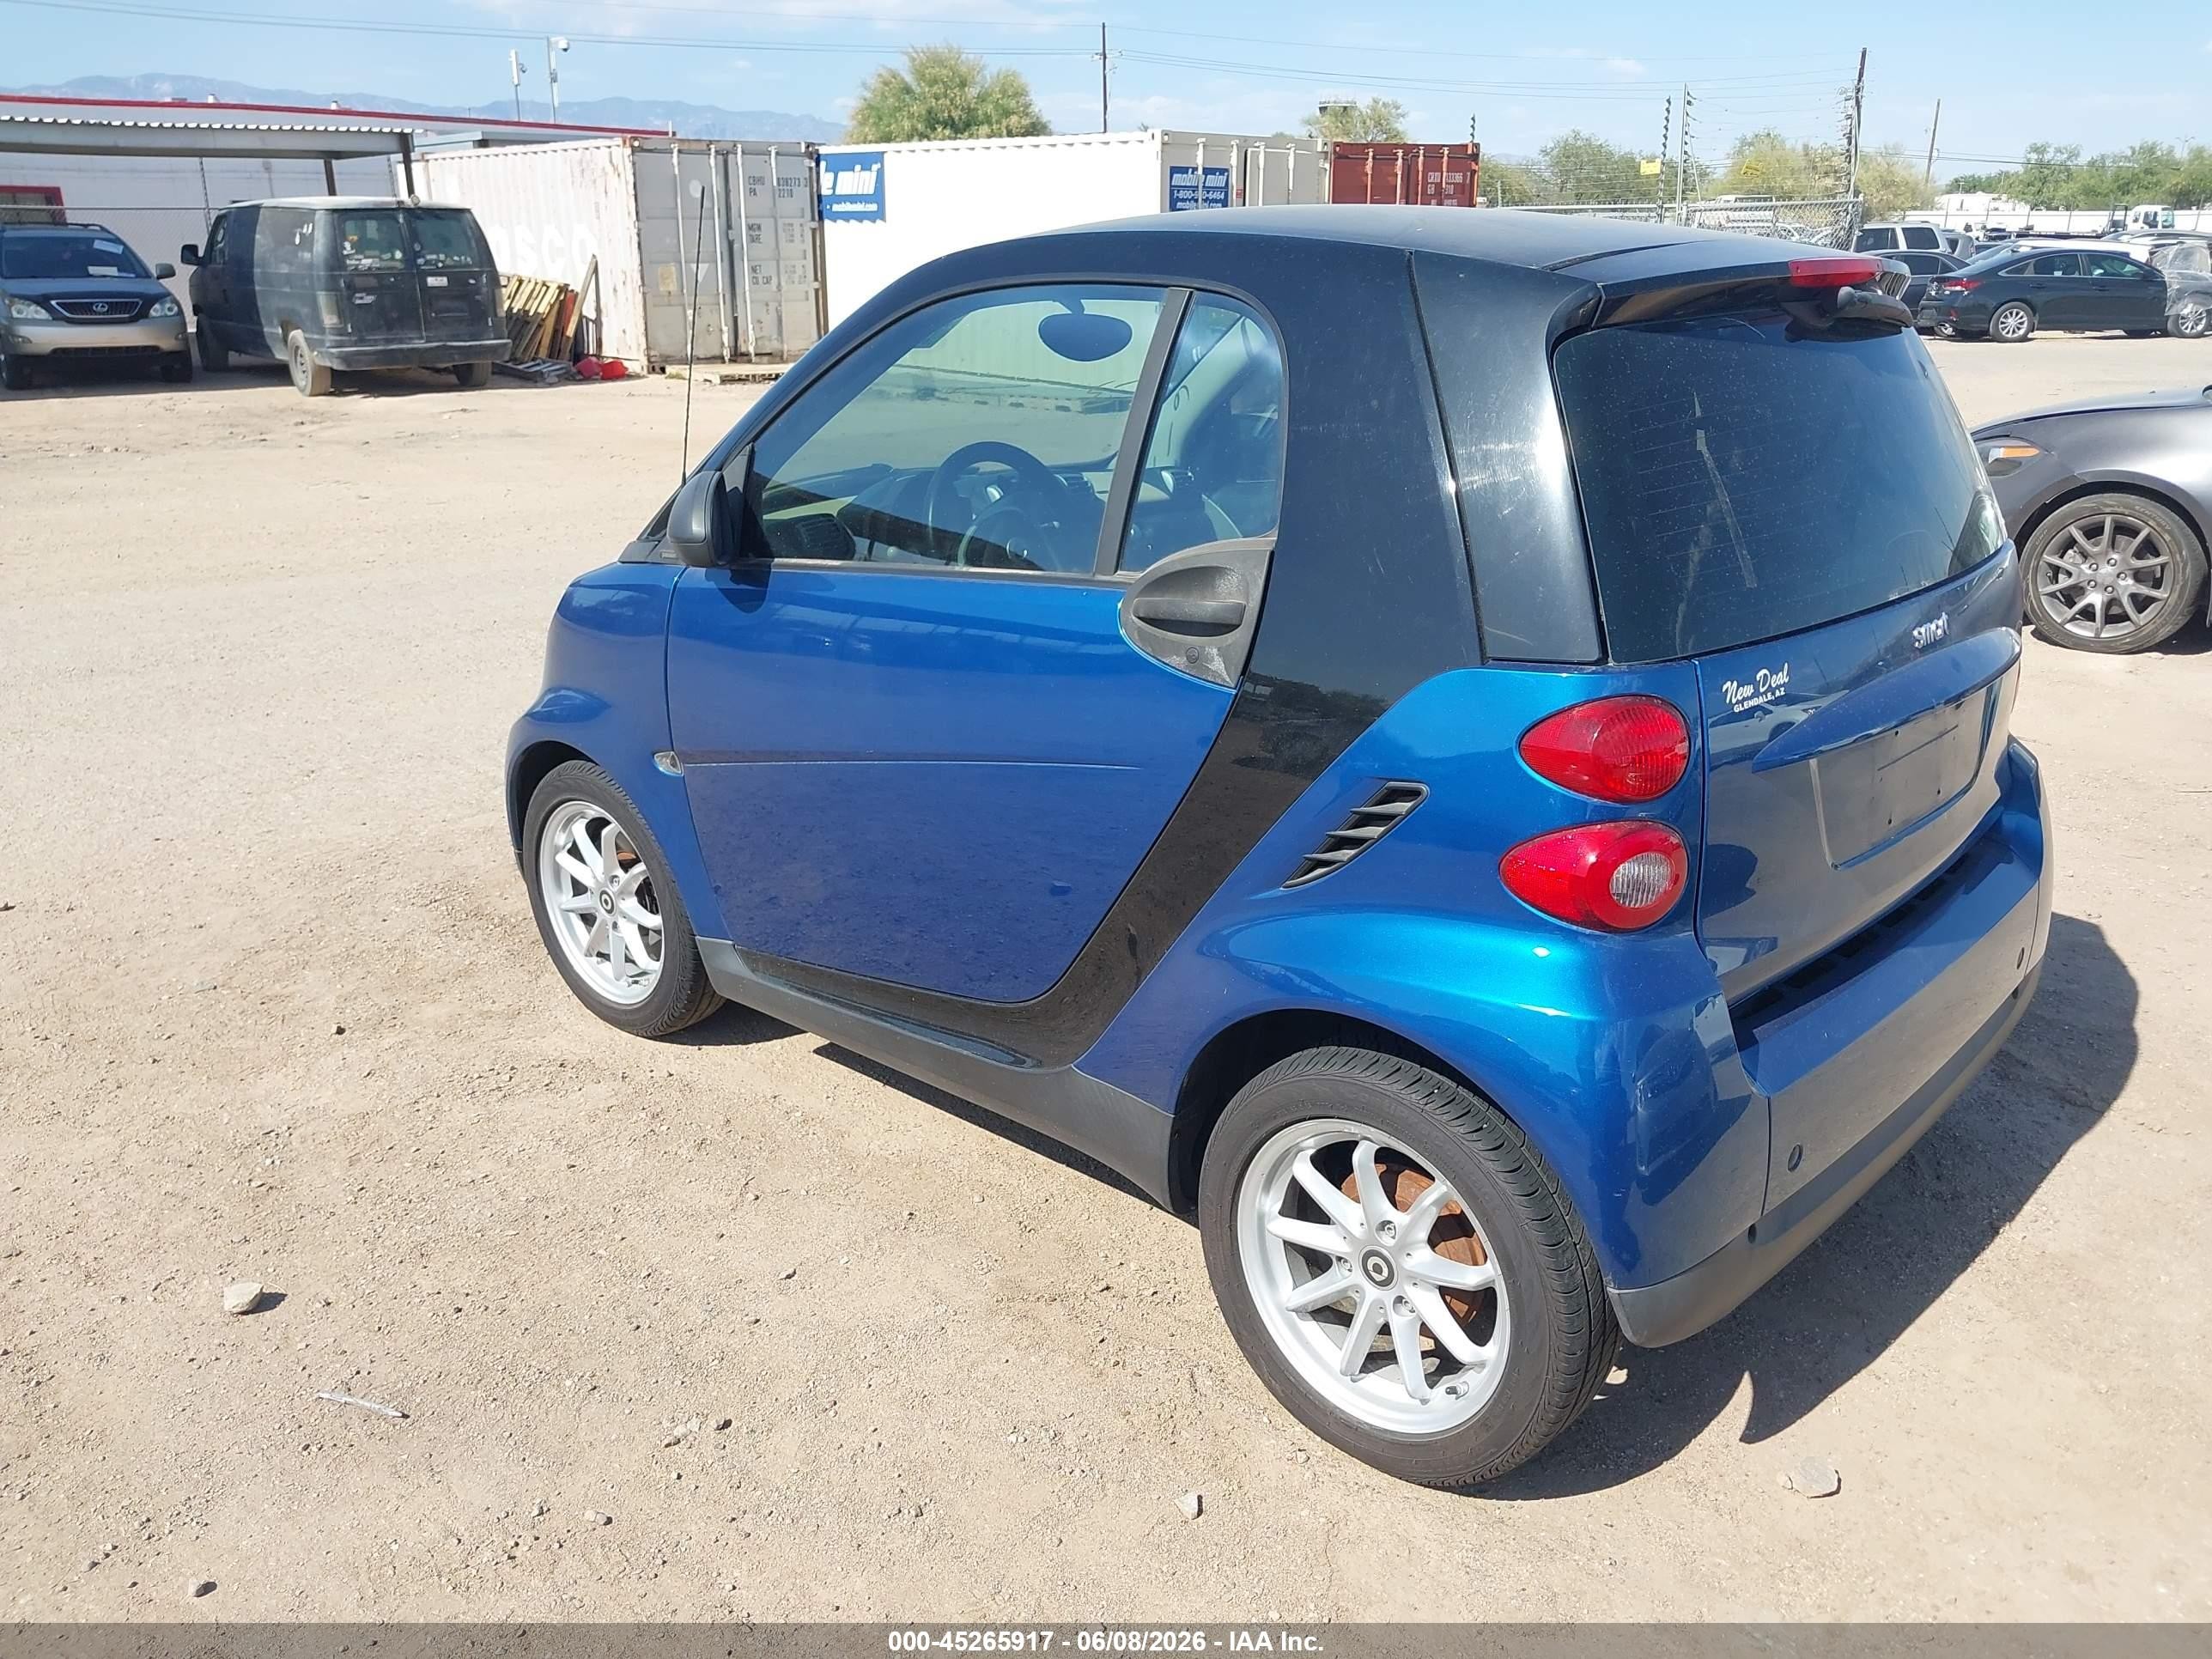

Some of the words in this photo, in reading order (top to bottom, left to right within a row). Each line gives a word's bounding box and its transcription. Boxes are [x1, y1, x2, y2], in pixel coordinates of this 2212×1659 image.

[1205, 172, 1228, 187] mini
[749, 234, 763, 244] TARE
[750, 264, 763, 275] NET
[1912, 611, 1950, 649] smart
[1722, 680, 1755, 704] New
[1756, 662, 1790, 693] Deal
[1733, 691, 1775, 713] GLENDALE,
[1775, 687, 1786, 698] AZ
